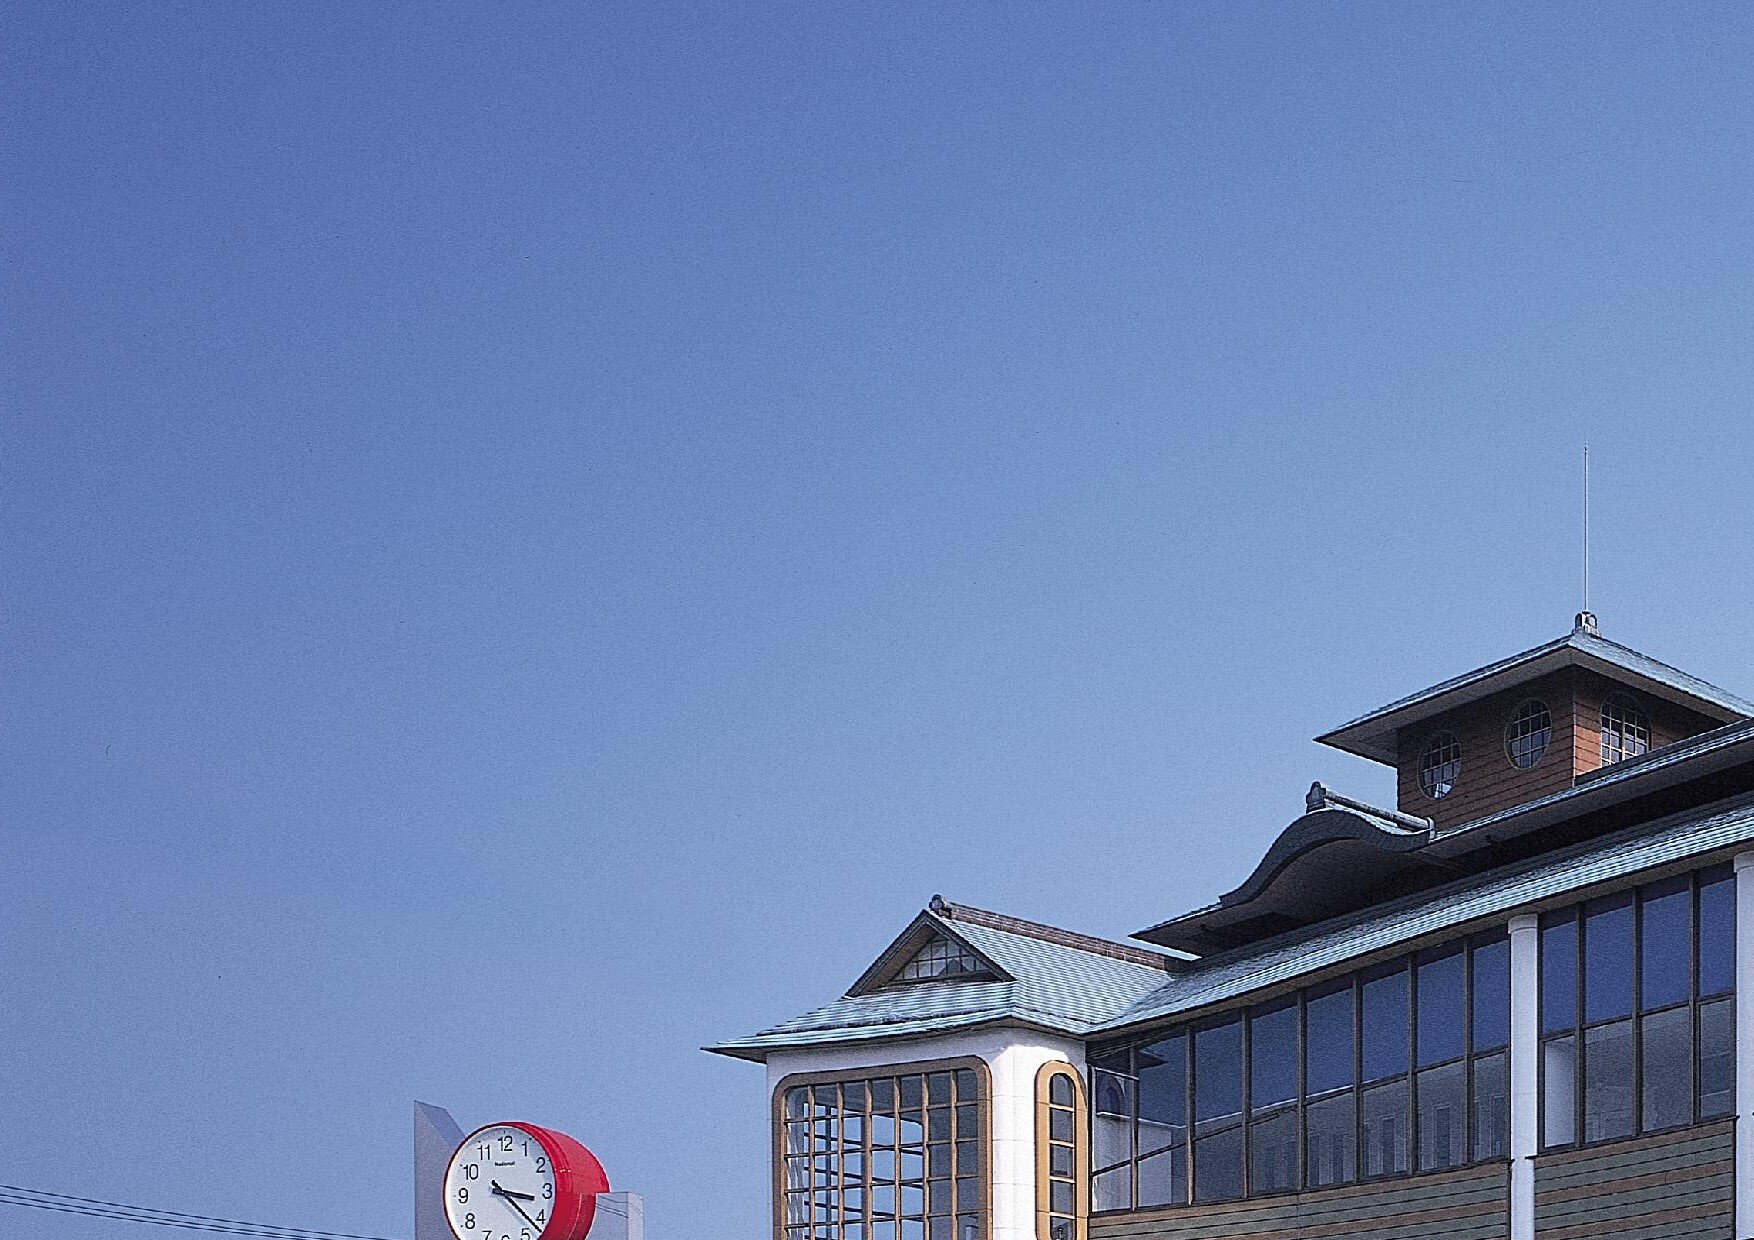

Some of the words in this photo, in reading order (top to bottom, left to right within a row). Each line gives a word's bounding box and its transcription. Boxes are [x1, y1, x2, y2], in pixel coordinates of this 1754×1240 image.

[498, 1135, 513, 1151] 12
[521, 1140, 529, 1157] 1
[477, 1144, 491, 1160] 11
[462, 1163, 479, 1180] 10
[536, 1157, 546, 1173] 2
[458, 1187, 469, 1204] 9
[541, 1182, 553, 1200] 3
[464, 1212, 476, 1230] 8
[535, 1208, 546, 1225] 4
